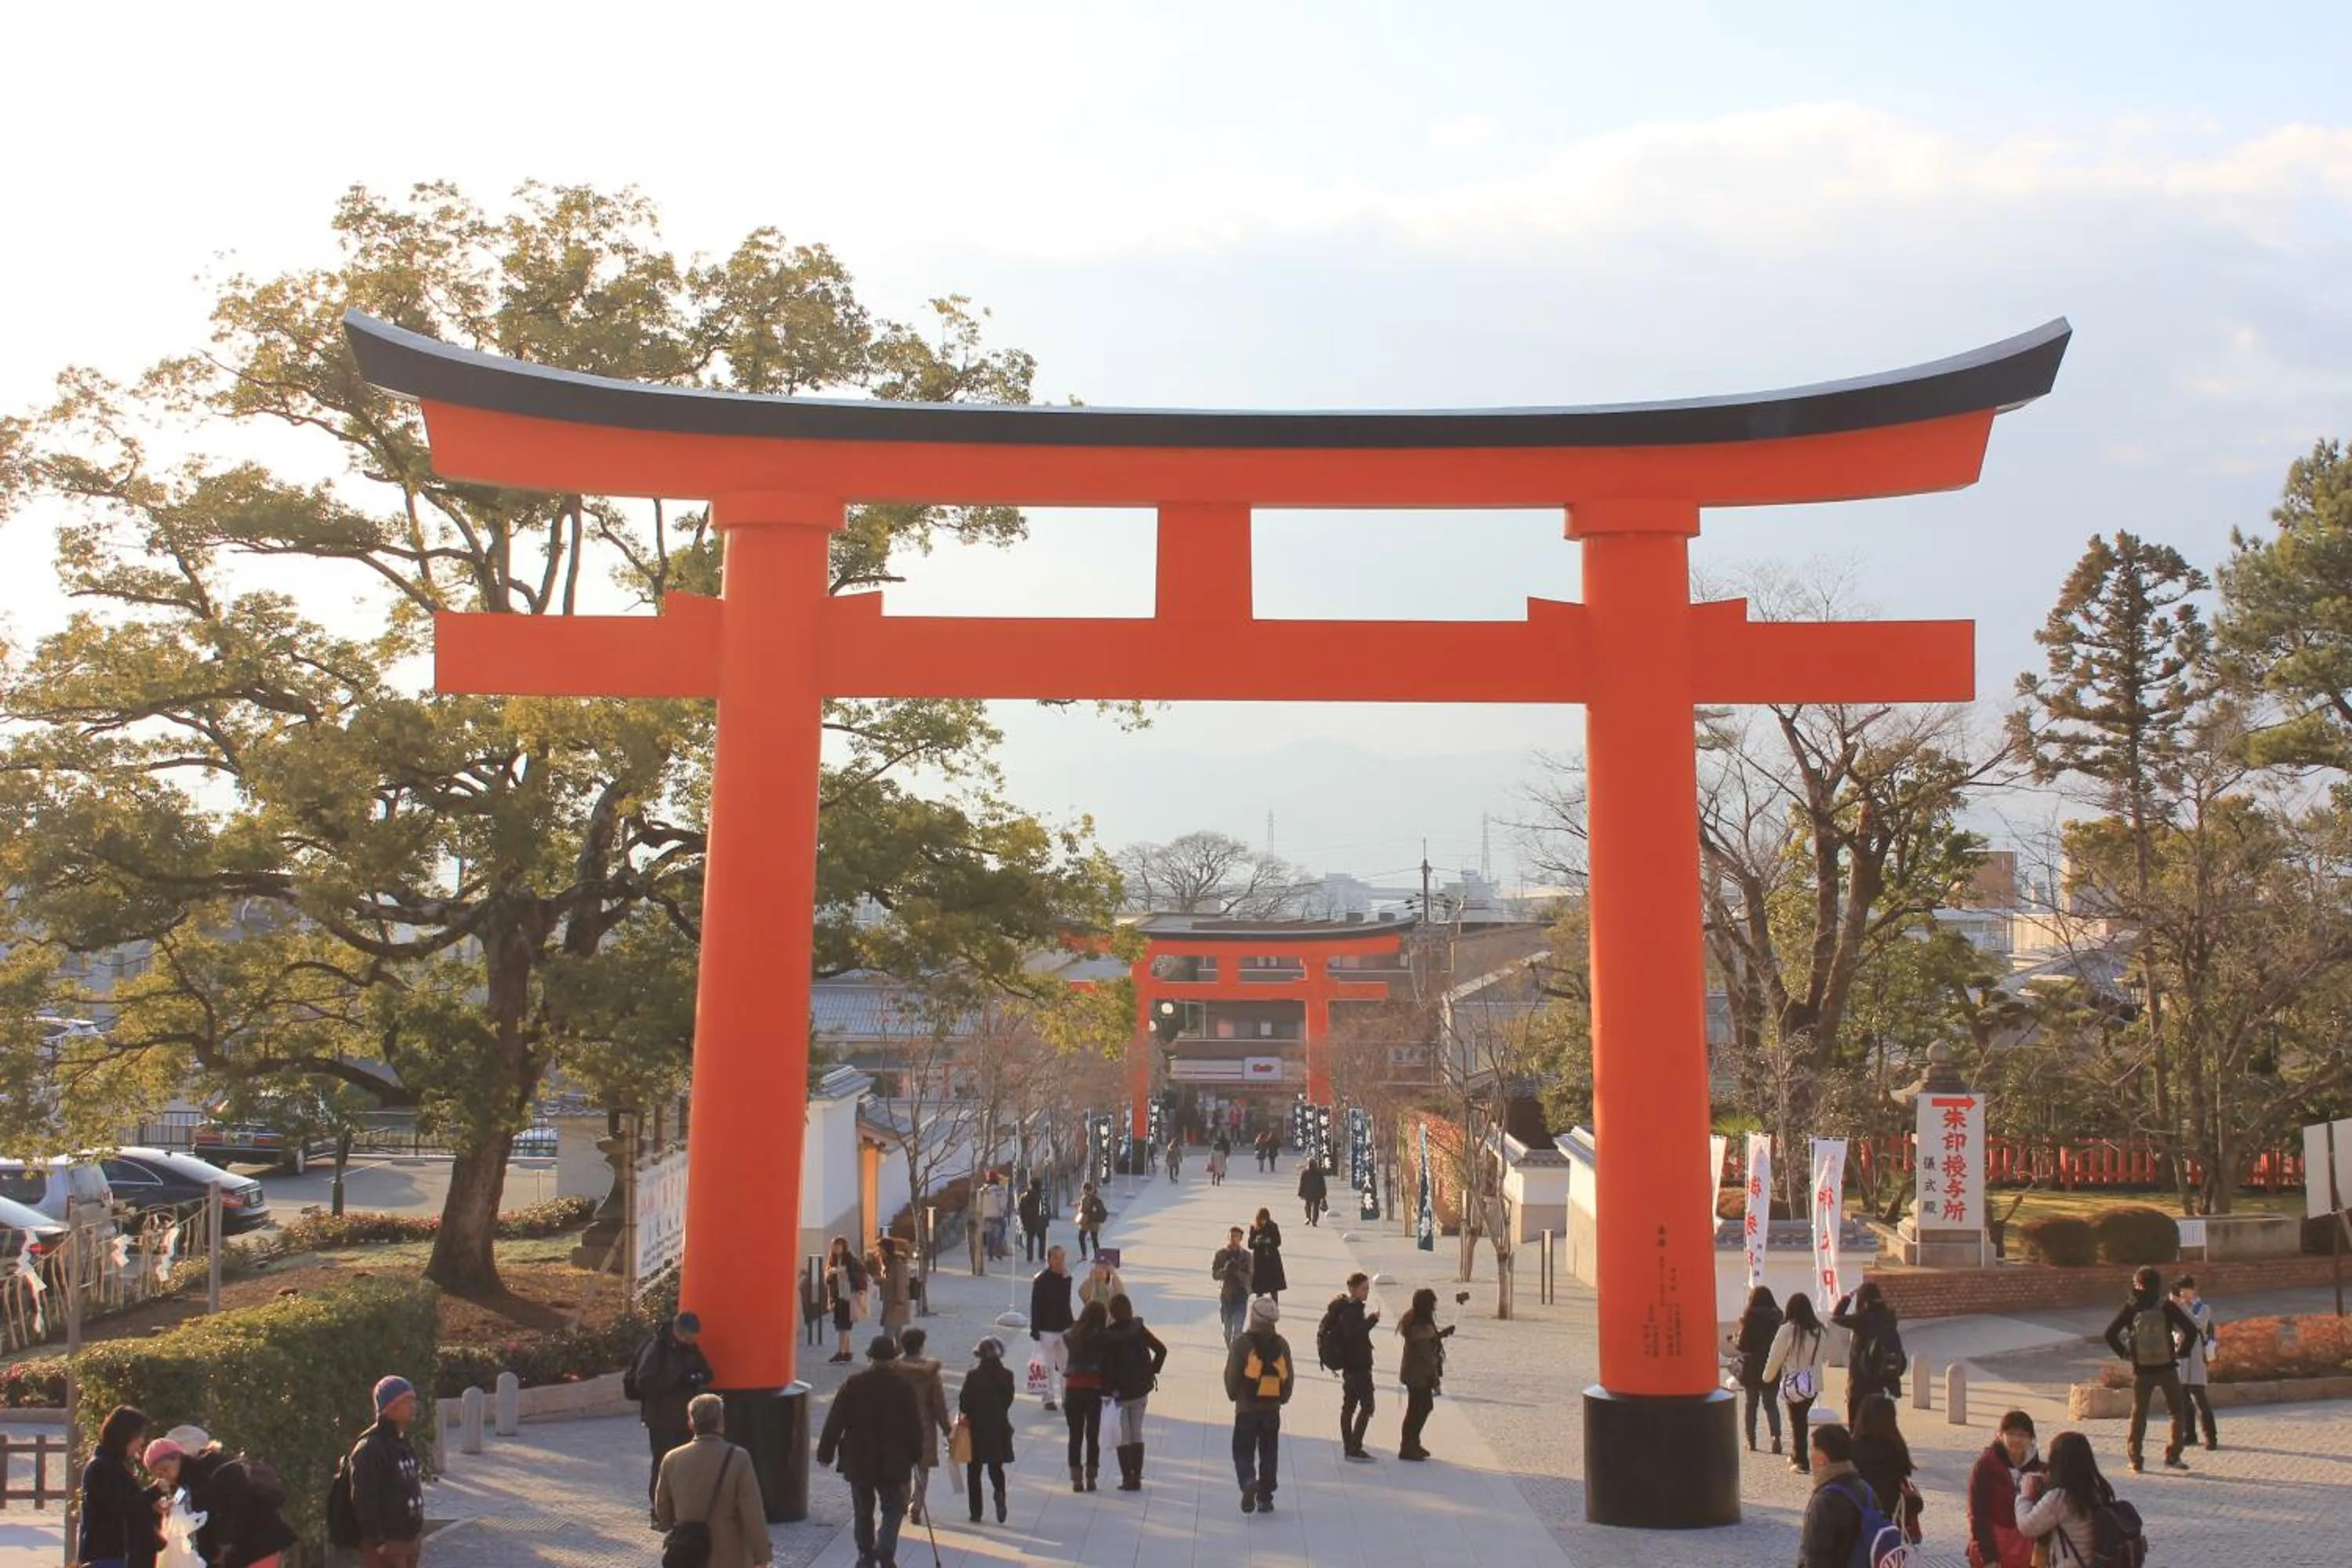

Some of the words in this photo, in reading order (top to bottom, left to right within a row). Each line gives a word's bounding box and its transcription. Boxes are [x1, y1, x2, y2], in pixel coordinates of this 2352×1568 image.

[1941, 1108, 1968, 1223] 朱印授与所
